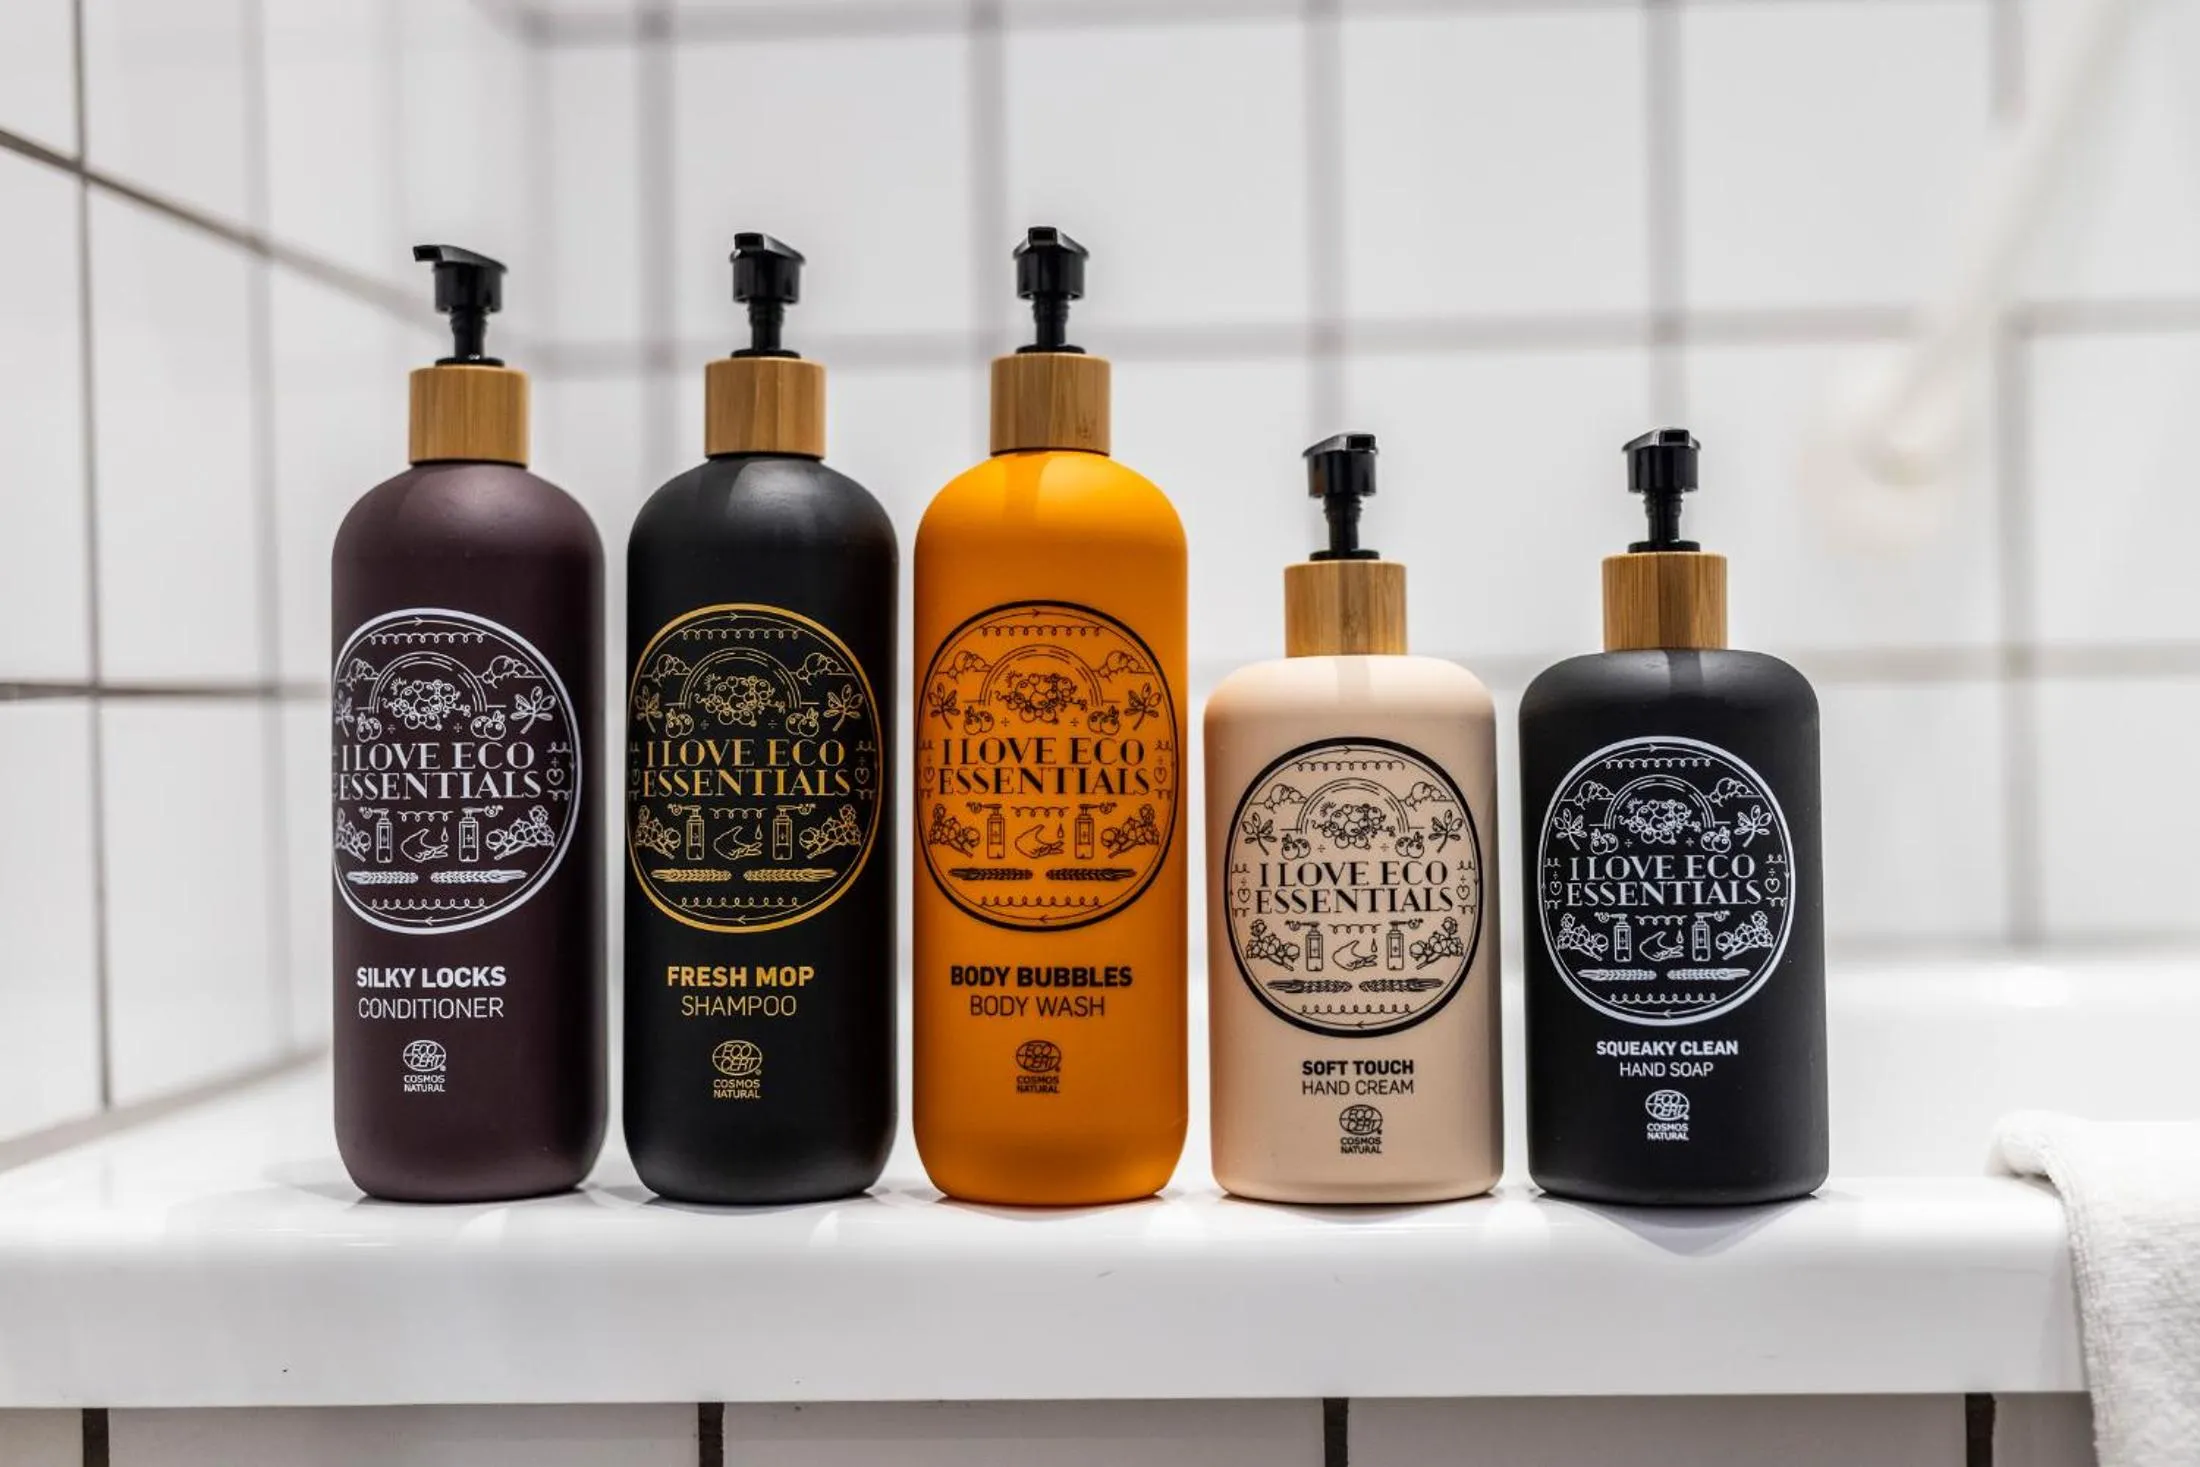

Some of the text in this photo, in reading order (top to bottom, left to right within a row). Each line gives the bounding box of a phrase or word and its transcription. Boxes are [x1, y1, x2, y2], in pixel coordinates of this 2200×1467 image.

[342, 741, 535, 771] I LOVE ECO
[646, 737, 845, 767] I LOVE ECO
[942, 737, 1145, 767] I LOVE ECO
[339, 770, 542, 800] ESSENTIALS
[642, 767, 851, 798] ESSENTIALS
[938, 766, 1151, 796] ESSENTIALS
[1259, 860, 1448, 888] I LOVE ECO
[1570, 854, 1755, 881] I LOVE ECO
[1255, 886, 1453, 915] ESSENTIALS
[1565, 879, 1762, 907] ESSENTIALS
[357, 966, 506, 988] SILKY LOCKS
[668, 966, 814, 987] FRESH MOP
[951, 965, 1132, 987] BODY BUBBLES
[358, 997, 504, 1019] CONDITIONER
[681, 995, 797, 1016] SHAMPOO
[970, 995, 1104, 1016] BODY WASH
[1596, 1040, 1738, 1056] SQUEAKY CLEAN
[1302, 1060, 1414, 1075] SOFT TOUCH
[1620, 1062, 1714, 1076] HAND SOAP
[404, 1075, 445, 1083] COSMOS
[404, 1084, 445, 1092] NATURAL
[713, 1079, 760, 1088] COSMOS
[1017, 1076, 1059, 1084] COSMOS
[1017, 1085, 1059, 1093] NATURAL
[1302, 1080, 1414, 1095] HAND CREAM
[713, 1089, 761, 1098] NATURAL
[1647, 1123, 1688, 1132] COSMOS
[1647, 1132, 1689, 1140] NATURAL
[1340, 1137, 1381, 1145] COSMOS
[1341, 1146, 1381, 1154] NATURAL
